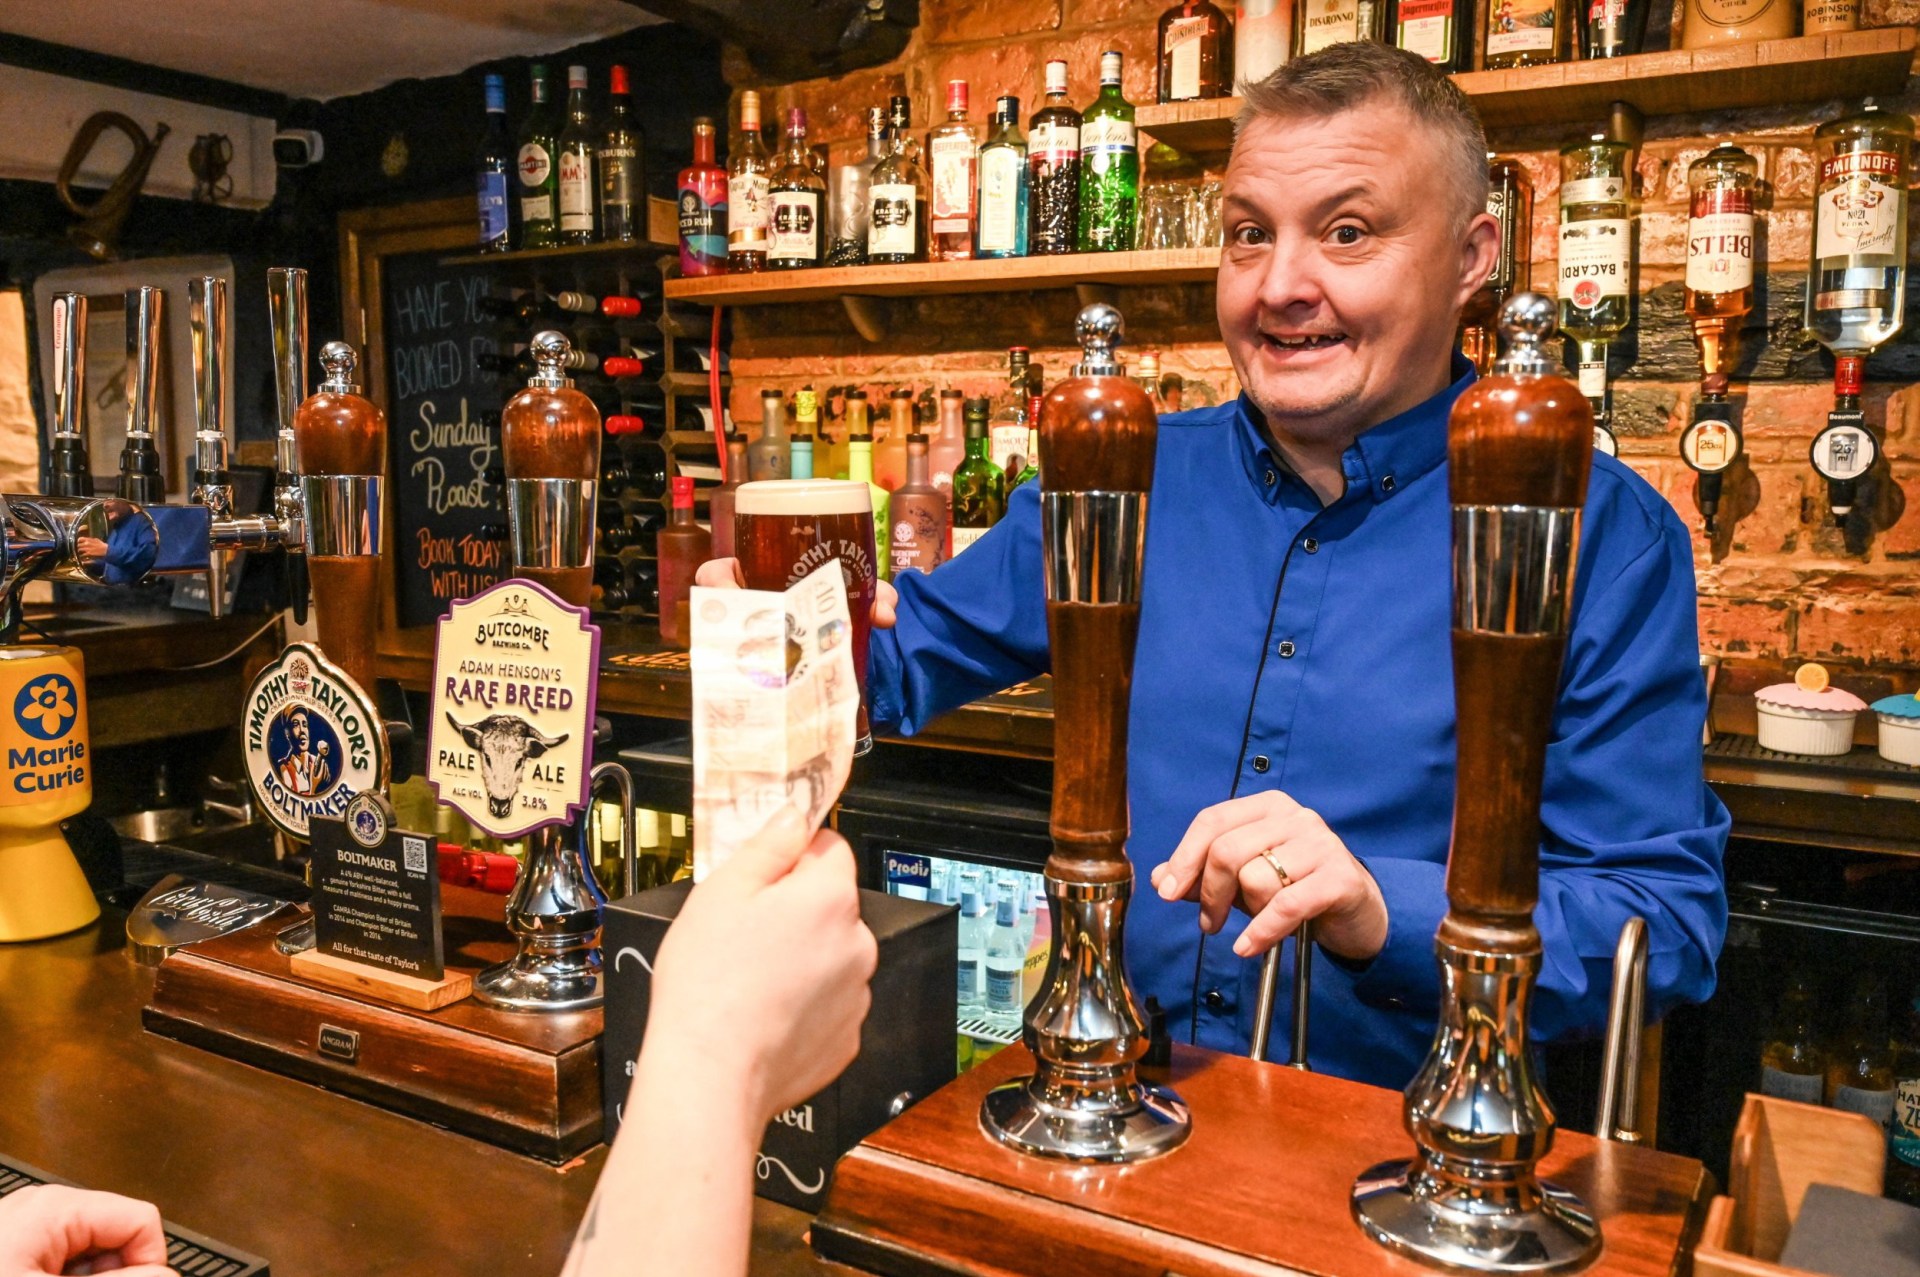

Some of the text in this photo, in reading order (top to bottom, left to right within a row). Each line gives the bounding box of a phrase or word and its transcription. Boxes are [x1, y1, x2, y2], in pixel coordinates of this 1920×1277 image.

[1310, 12, 1354, 27] DISARONNO
[1835, 14, 1848, 22] ME
[562, 164, 588, 179] MM'S
[1824, 154, 1897, 178] SMINOFF
[1562, 263, 1617, 279] BACARDI
[396, 280, 452, 336] HAVE
[394, 340, 460, 401] BOOKED
[1829, 412, 1862, 420] Beaumont
[410, 398, 499, 471] Sunday
[417, 527, 500, 569] BOOK TODAY
[430, 571, 467, 599] WITH
[475, 622, 550, 651] BUTCOMBE
[492, 640, 519, 649] BREWING
[459, 660, 562, 682] ADAM HENSON'S
[445, 676, 573, 714] RARE BREED
[249, 672, 371, 771] TIMOTHY TAYLOR'S
[8, 739, 84, 770] Marie
[439, 750, 476, 771] PALE
[13, 764, 84, 794] Curie
[532, 763, 565, 784] ALE
[262, 770, 357, 821] BOLTMAKER
[521, 796, 548, 811] 3.8%
[336, 849, 398, 873] BOLTMAKER
[889, 859, 929, 877] Prodis
[348, 880, 371, 891] Yorkshire
[373, 895, 383, 903] and
[387, 899, 402, 909] hoppy
[333, 904, 350, 915] CAMRA
[351, 908, 376, 920] Champion
[376, 913, 388, 923] Beer
[394, 918, 412, 928] Britain
[346, 917, 355, 925] and
[355, 919, 380, 930] Champion
[380, 924, 394, 934] Bitter
[400, 929, 418, 939] Britain
[332, 941, 420, 971] All for that taste of Taylor's
[321, 1035, 352, 1051] ANGRAM
